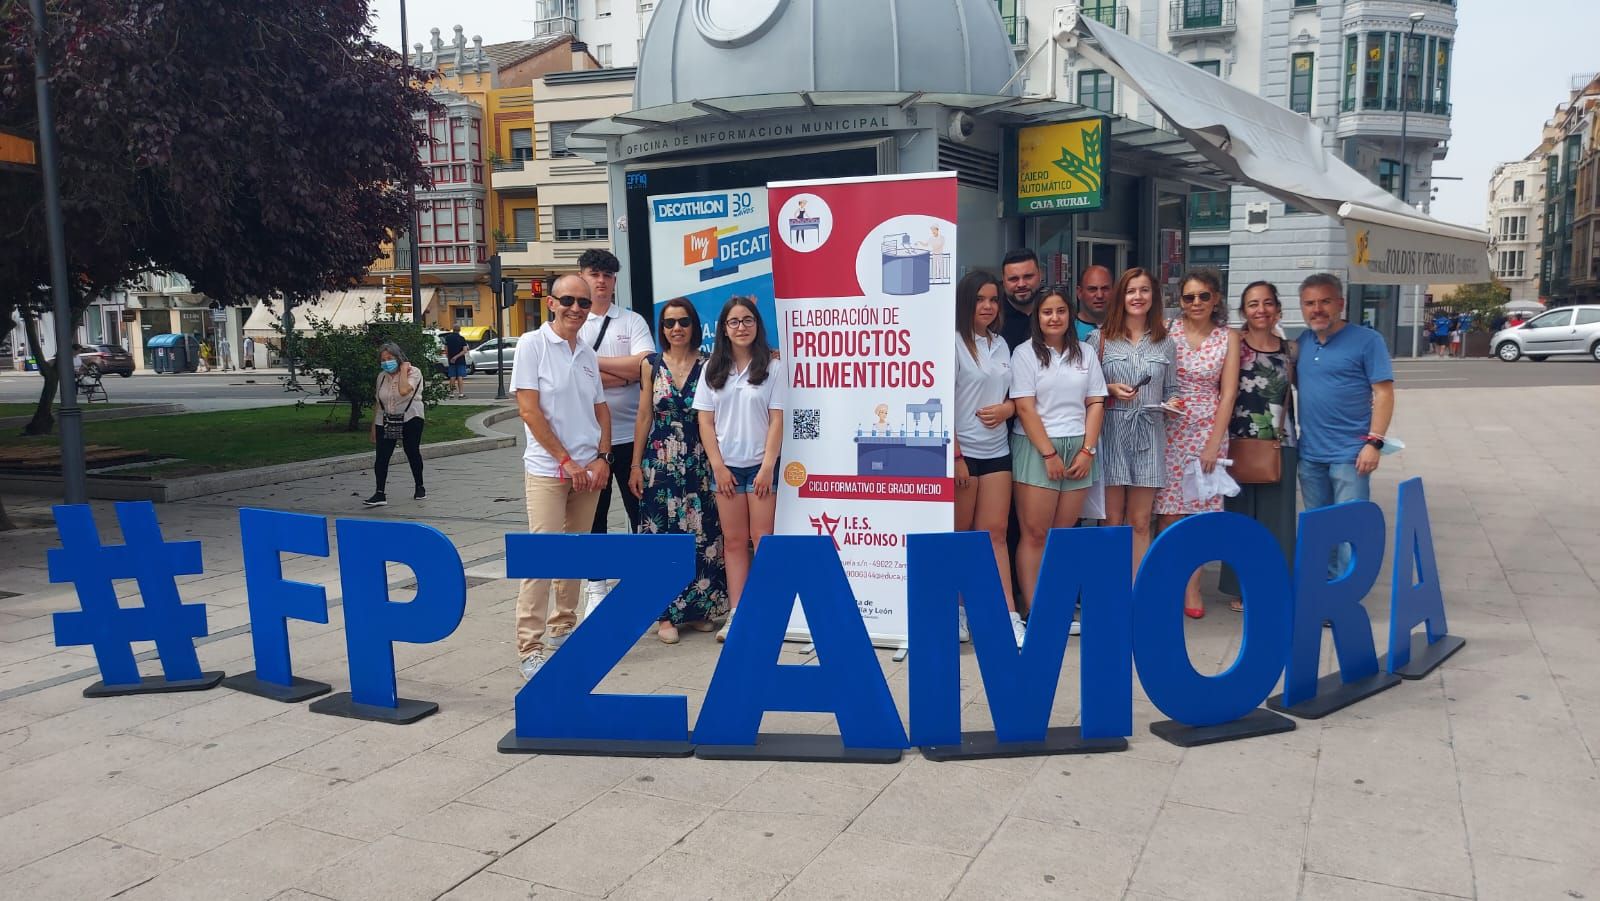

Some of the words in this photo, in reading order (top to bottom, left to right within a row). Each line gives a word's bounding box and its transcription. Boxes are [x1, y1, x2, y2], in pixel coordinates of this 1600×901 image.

[626, 139, 669, 155] OFICINA
[674, 135, 689, 147] DE
[695, 124, 793, 144] INFORMACIÓN
[801, 117, 890, 133] MUNICIPAL
[1020, 170, 1049, 181] CAJERO
[658, 199, 724, 218] DECATHLON
[732, 192, 752, 213] 30
[1030, 200, 1054, 210] CAJA
[1056, 196, 1091, 208] RURAL
[1385, 248, 1416, 275] TOLDOS
[792, 305, 879, 327] ELABORACIÓN
[883, 307, 900, 325] DE
[793, 329, 911, 357] PRODUCTOS
[793, 361, 935, 388] ALIMENTICIOS
[808, 480, 829, 492] CICLO
[830, 481, 875, 494] FORMATIVO
[876, 483, 887, 494] DE
[888, 483, 915, 495] GRADO
[916, 483, 942, 496] MEDIO
[844, 516, 872, 530] I.E.S.
[844, 532, 898, 547] ALFONSO
[864, 599, 873, 607] de
[868, 608, 874, 616] y
[874, 607, 893, 615] León
